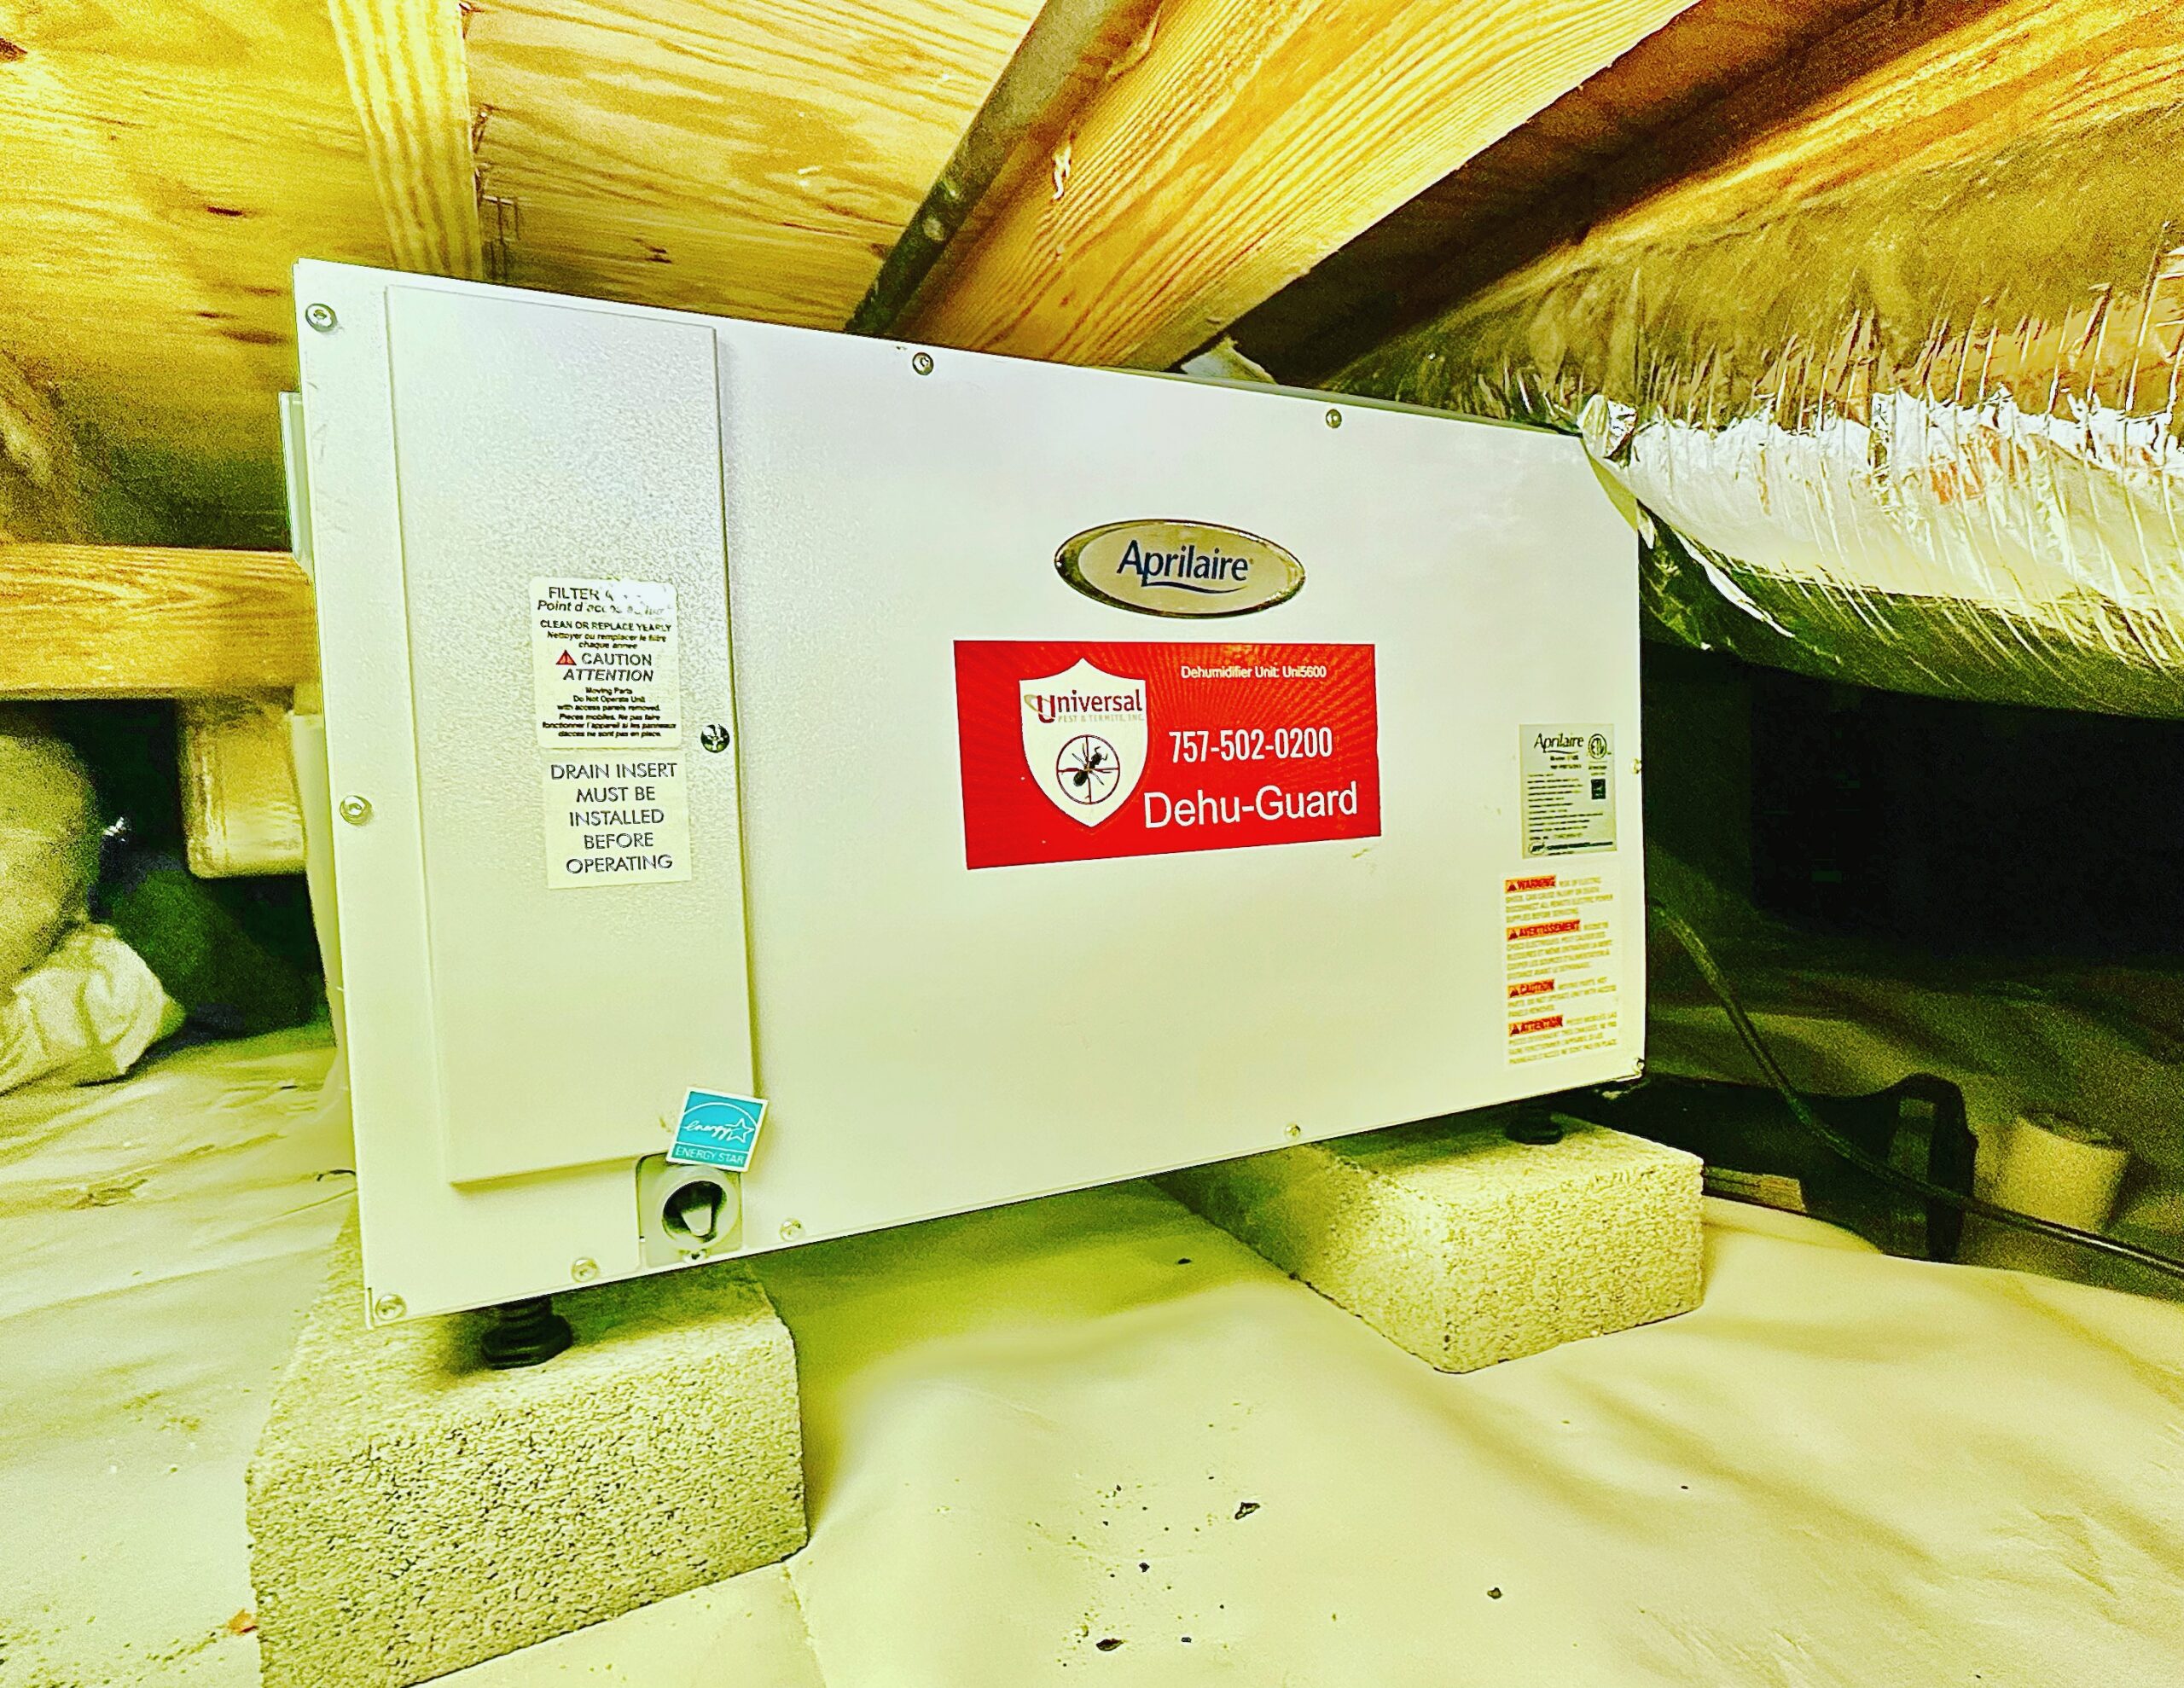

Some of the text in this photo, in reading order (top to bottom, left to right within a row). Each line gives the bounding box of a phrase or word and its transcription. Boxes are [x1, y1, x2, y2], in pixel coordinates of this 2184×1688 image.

[1117, 539, 1250, 588] Aprilaire
[548, 586, 600, 600] FILTER
[537, 600, 572, 612] Point
[539, 619, 671, 632] CLEAN OR REPLACE YEARLY
[581, 653, 652, 666] CAUTION
[562, 668, 654, 682] ATTENTION
[1181, 665, 1327, 679] Dehumidifier Unit: Uni5600
[1037, 689, 1143, 723] Universal
[1169, 726, 1333, 764] 757-502-0200
[1533, 733, 1584, 753] Aprilaire
[550, 763, 677, 780] DRAIN INSERT
[576, 786, 656, 803] MUST BE
[1144, 780, 1358, 829] Dehu-Guard
[569, 809, 665, 827] INSTALLED
[584, 832, 654, 850] BEFORE
[566, 854, 673, 874] OPERATING
[676, 1146, 744, 1164] ENERGY STAR
